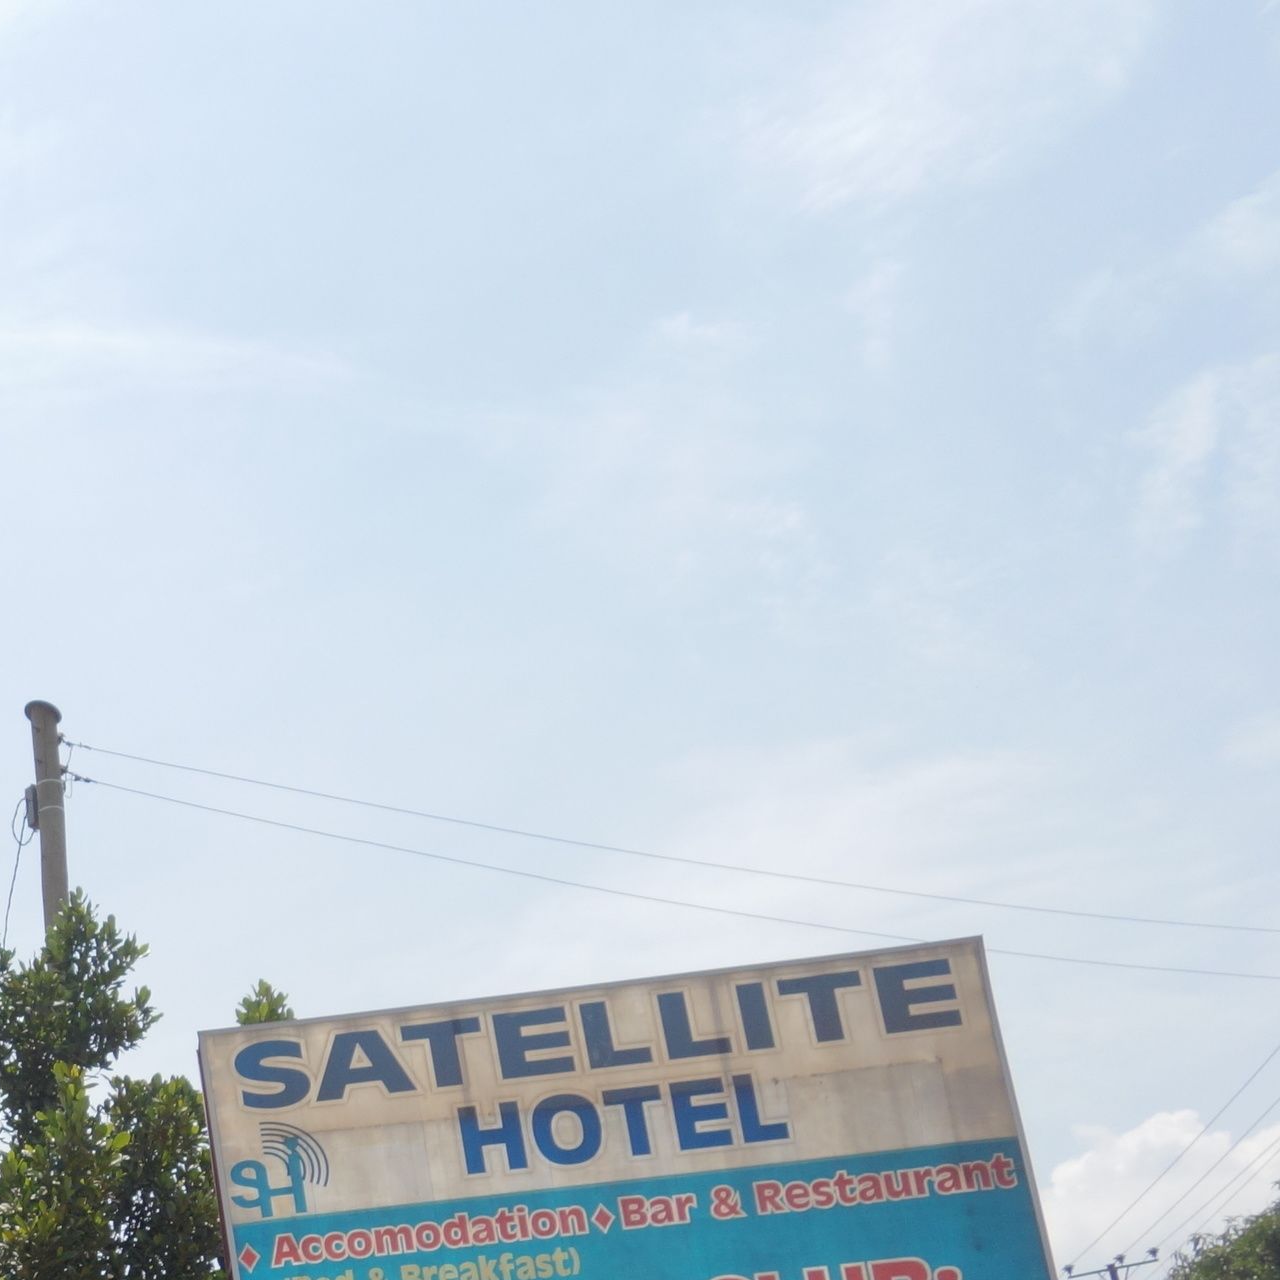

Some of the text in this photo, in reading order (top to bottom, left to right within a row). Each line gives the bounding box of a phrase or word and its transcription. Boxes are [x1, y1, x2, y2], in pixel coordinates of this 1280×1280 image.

[234, 958, 963, 1110] SATELLITE
[458, 1075, 789, 1175] HOTEL
[271, 1152, 1017, 1269] Accomodation Bar & Restaurant
